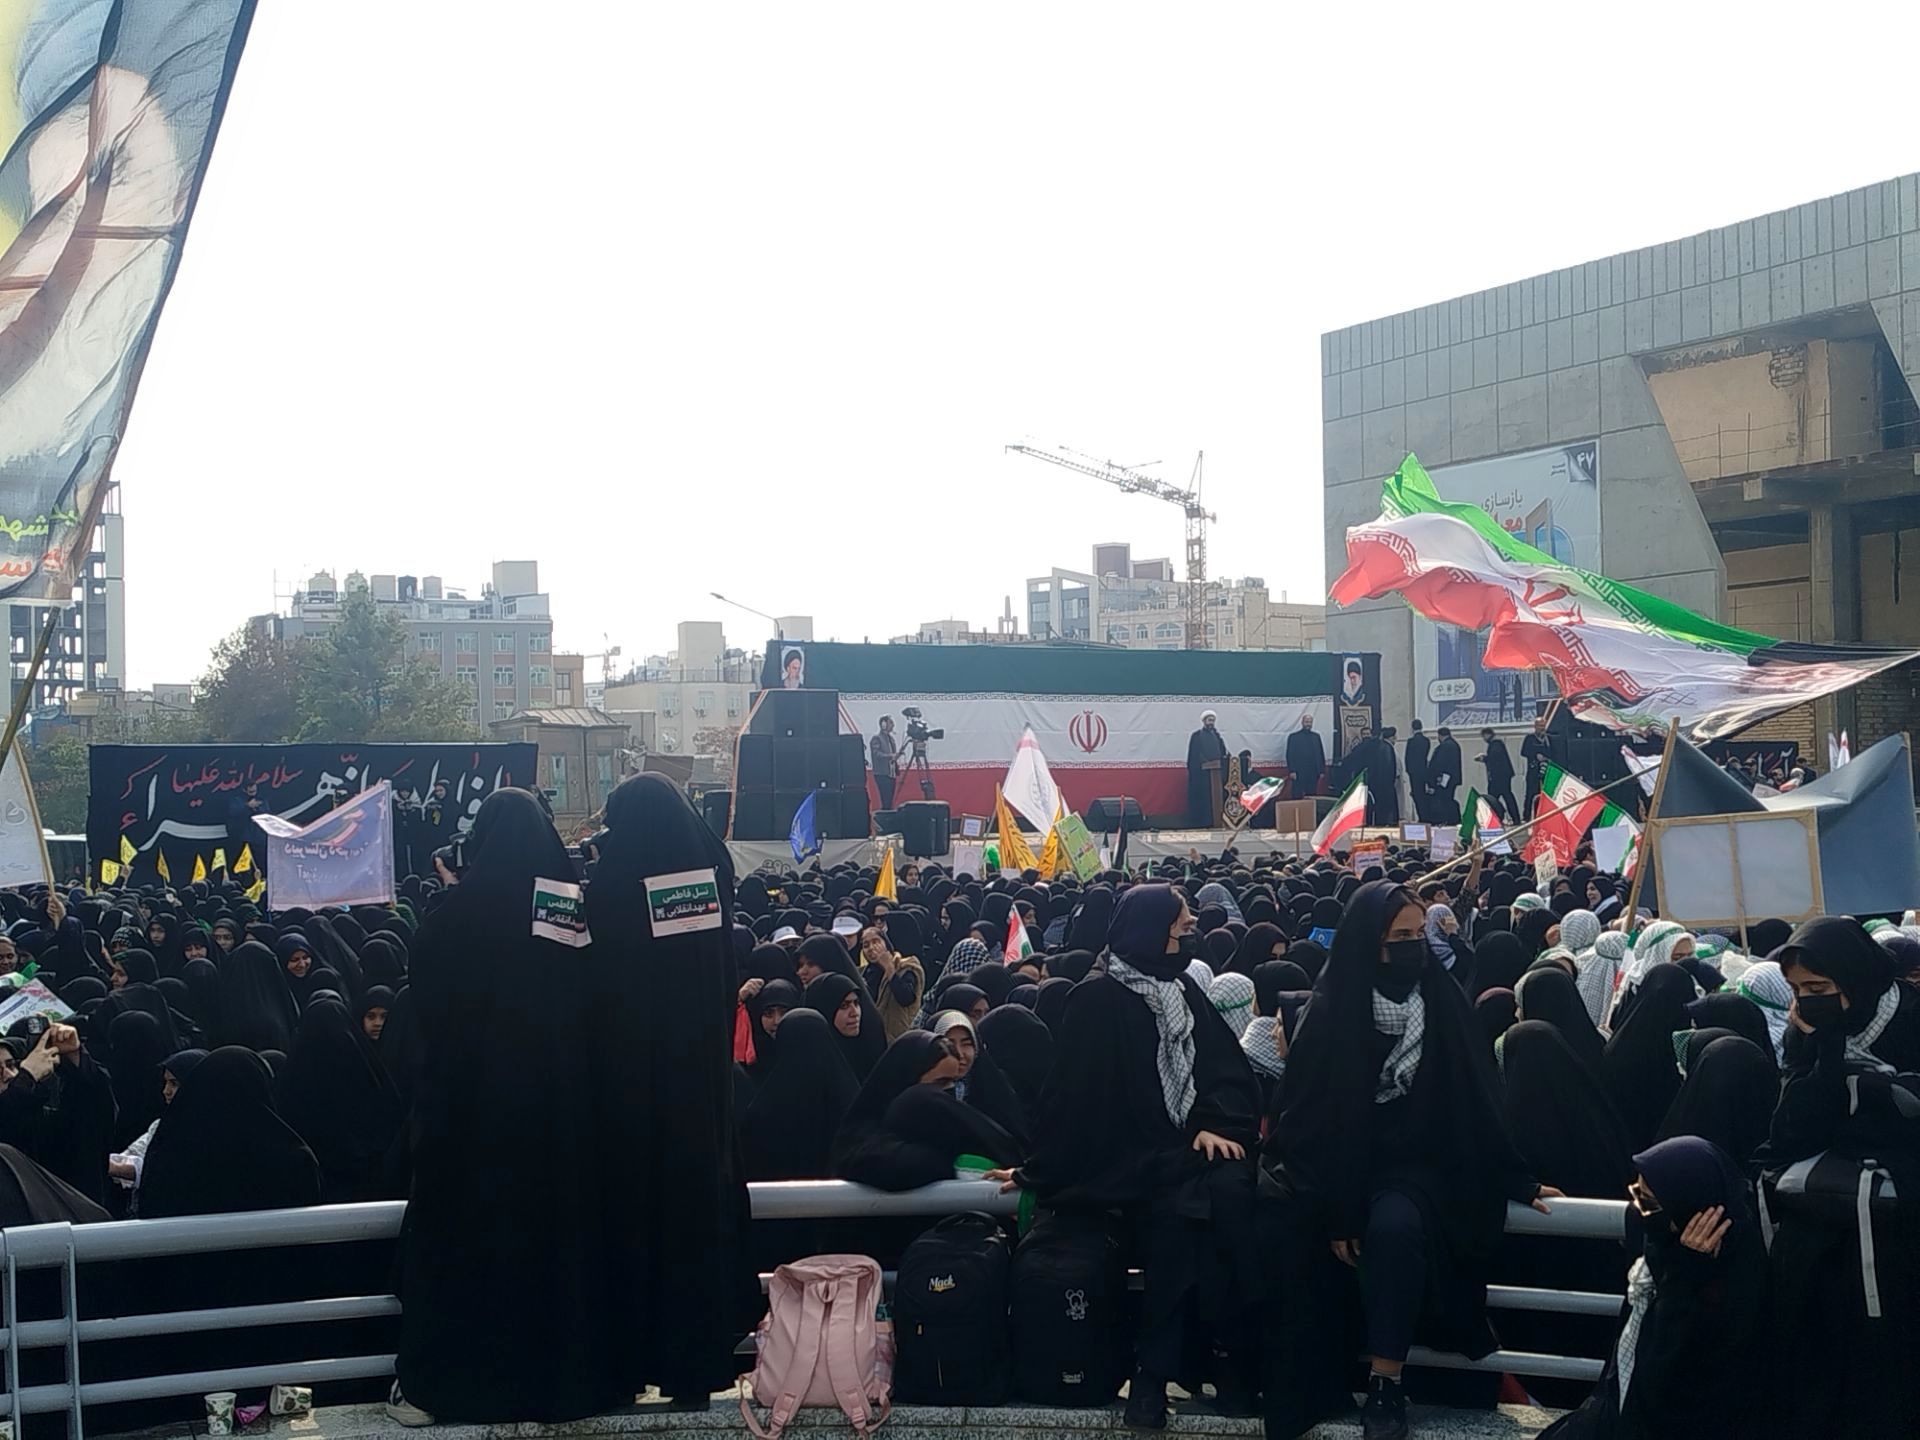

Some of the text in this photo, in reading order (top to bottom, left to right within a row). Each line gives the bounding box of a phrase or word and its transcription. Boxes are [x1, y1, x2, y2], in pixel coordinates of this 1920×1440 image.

[1576, 451, 1594, 470] ۴۷
[1481, 488, 1523, 513] بازسازی
[662, 887, 709, 903] نسل فاطمی
[547, 899, 575, 911] فاطمی
